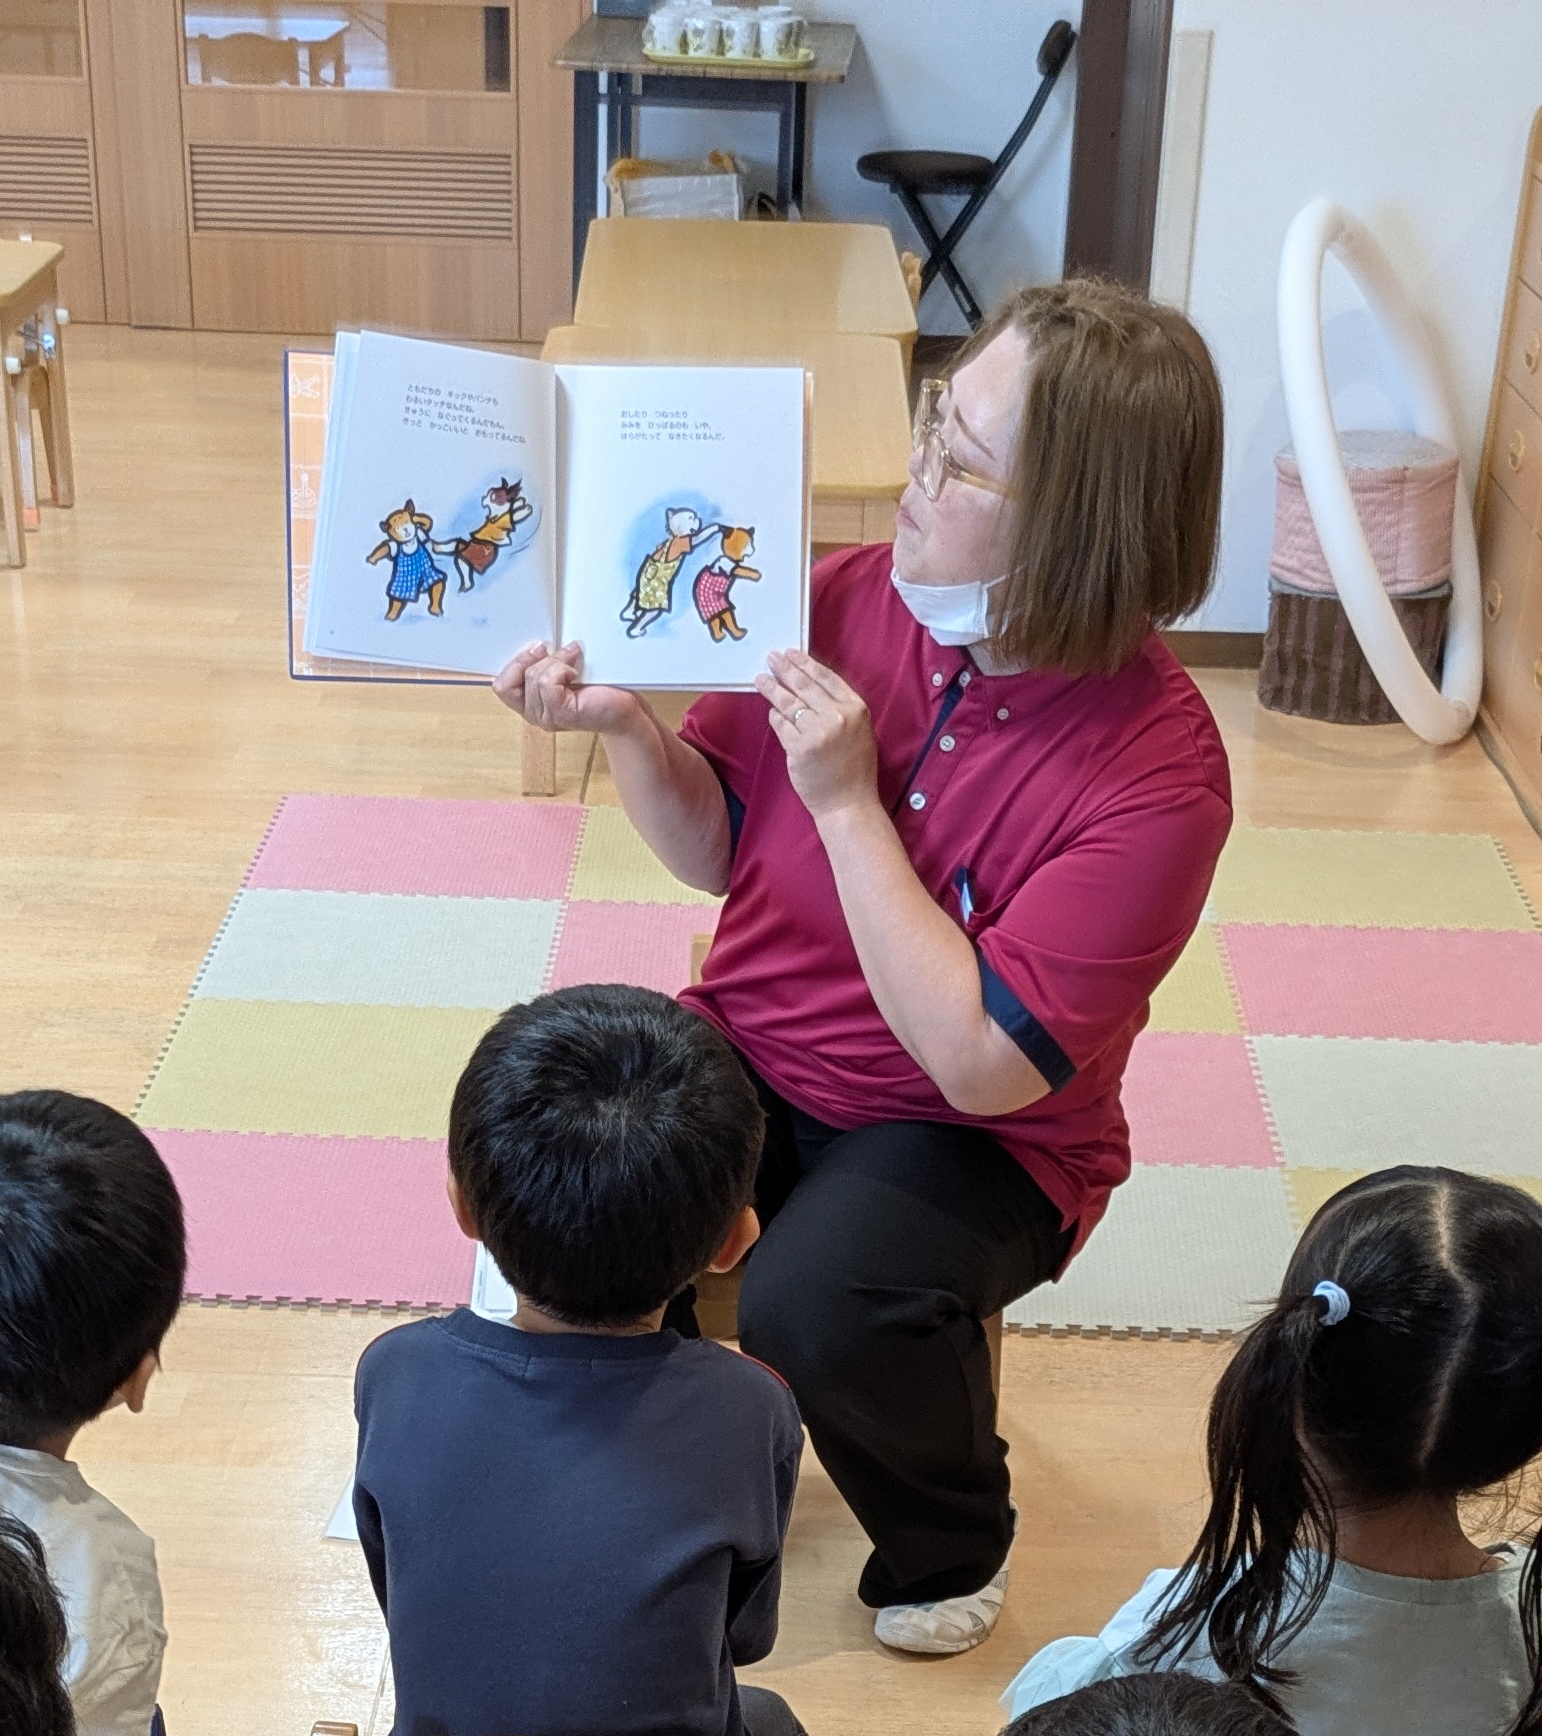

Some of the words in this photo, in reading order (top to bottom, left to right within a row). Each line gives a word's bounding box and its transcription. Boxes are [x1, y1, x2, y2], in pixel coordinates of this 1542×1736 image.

[407, 383, 441, 396] ともだちの
[621, 410, 648, 418] おしたり
[655, 410, 688, 419] つねったり
